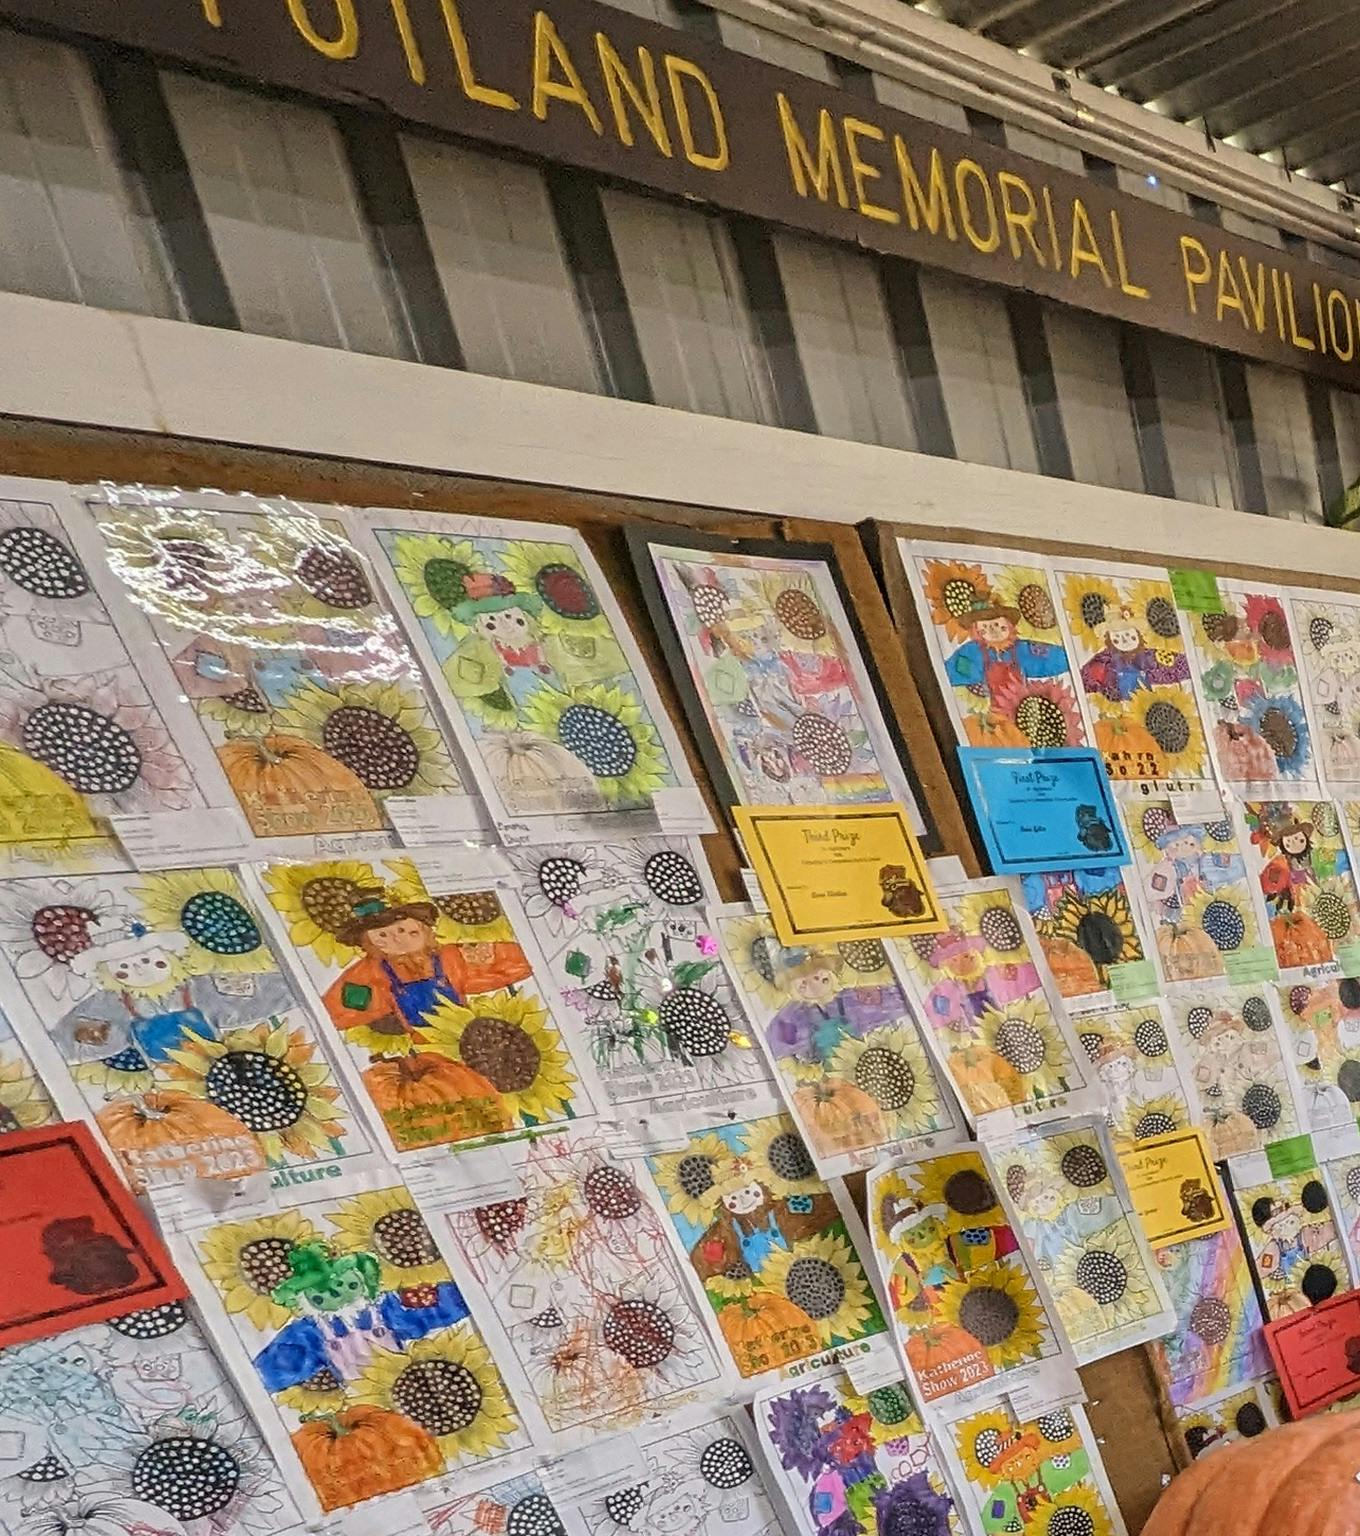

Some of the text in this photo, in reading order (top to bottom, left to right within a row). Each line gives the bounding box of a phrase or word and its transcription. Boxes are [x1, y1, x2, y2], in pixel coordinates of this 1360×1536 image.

[776, 92, 1150, 299] MEMORIAL
[270, 1163, 343, 1190] ulture
[917, 1350, 984, 1383] Katherine
[922, 1375, 958, 1398] Show
[960, 1360, 989, 1383] 2023
